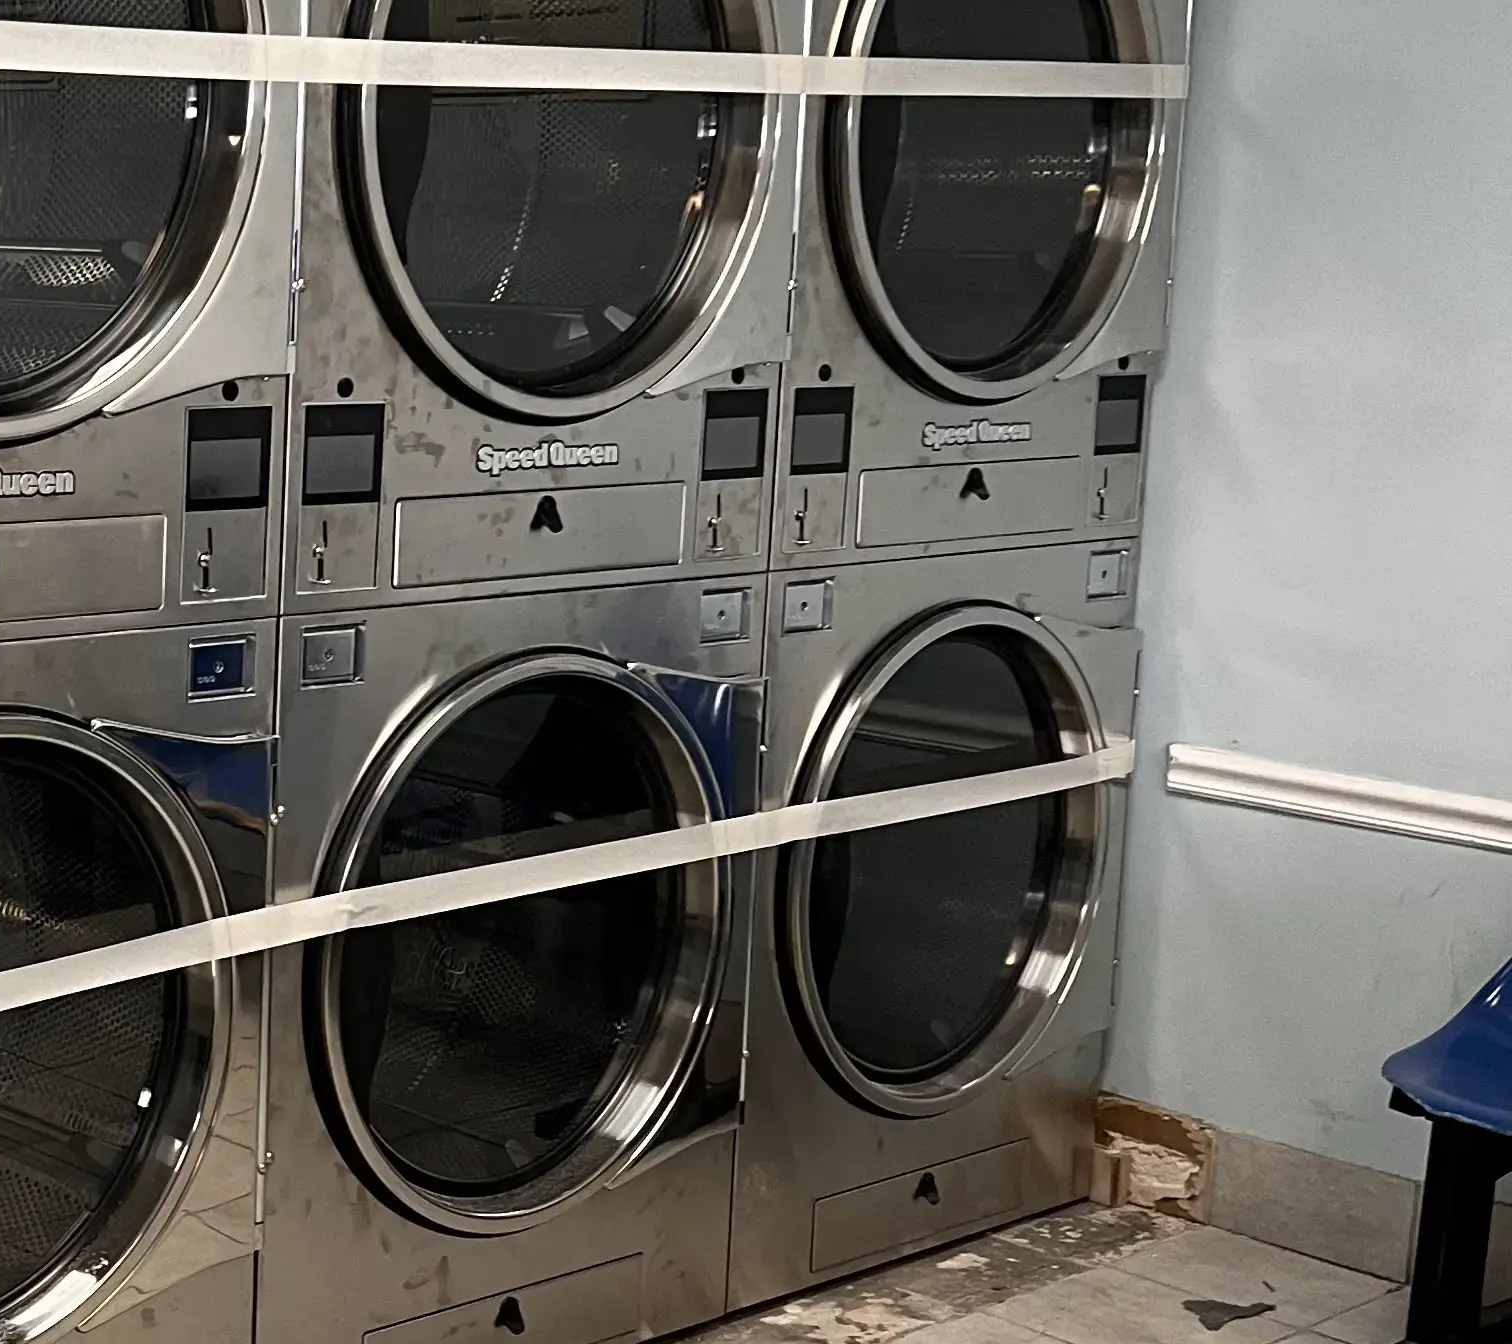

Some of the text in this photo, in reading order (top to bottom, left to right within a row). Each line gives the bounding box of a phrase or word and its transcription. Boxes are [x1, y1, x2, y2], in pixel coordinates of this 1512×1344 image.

[922, 418, 1030, 450] Speed Queen
[477, 440, 618, 476] Speed Queen
